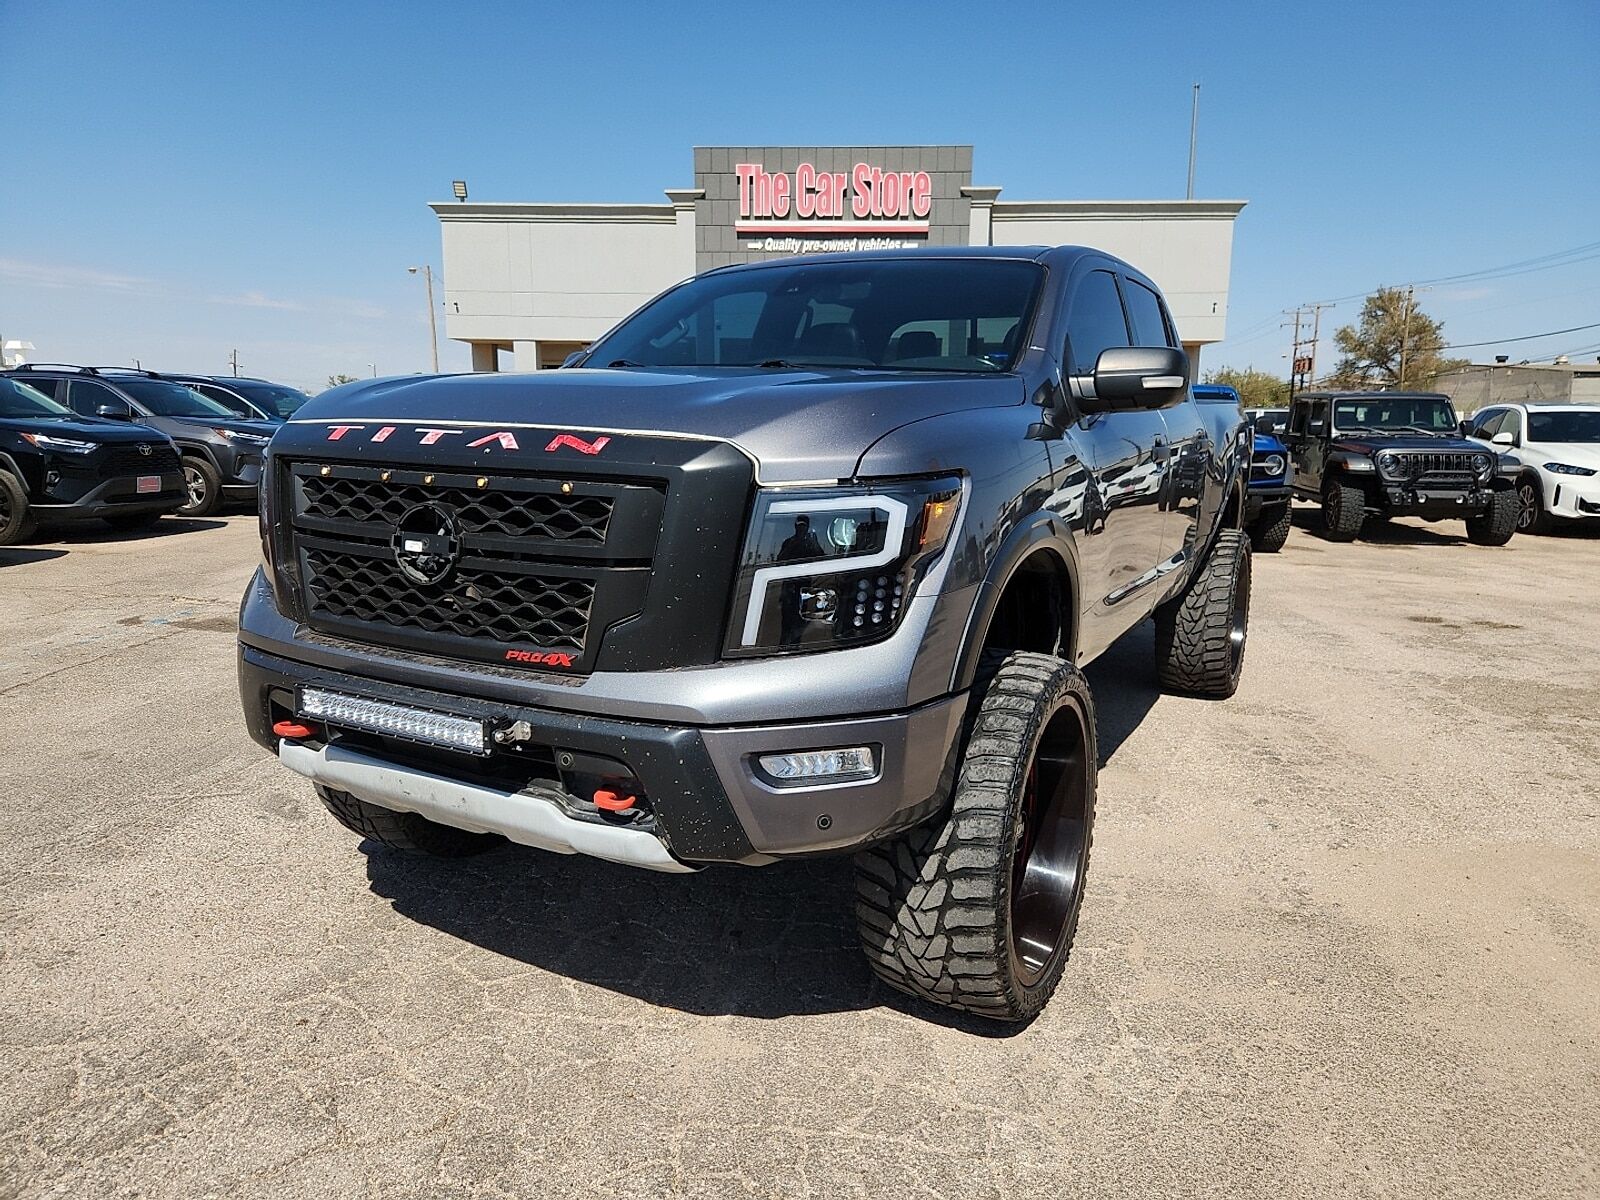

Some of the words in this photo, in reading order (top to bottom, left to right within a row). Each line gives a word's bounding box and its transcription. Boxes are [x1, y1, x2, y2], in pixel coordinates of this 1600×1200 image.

[736, 163, 790, 218] The
[796, 163, 847, 218] Car
[852, 162, 932, 218] Store
[764, 238, 801, 253] Quality
[802, 238, 857, 254] pre-owned
[858, 238, 902, 251] vehicles
[326, 425, 612, 455] TITAN
